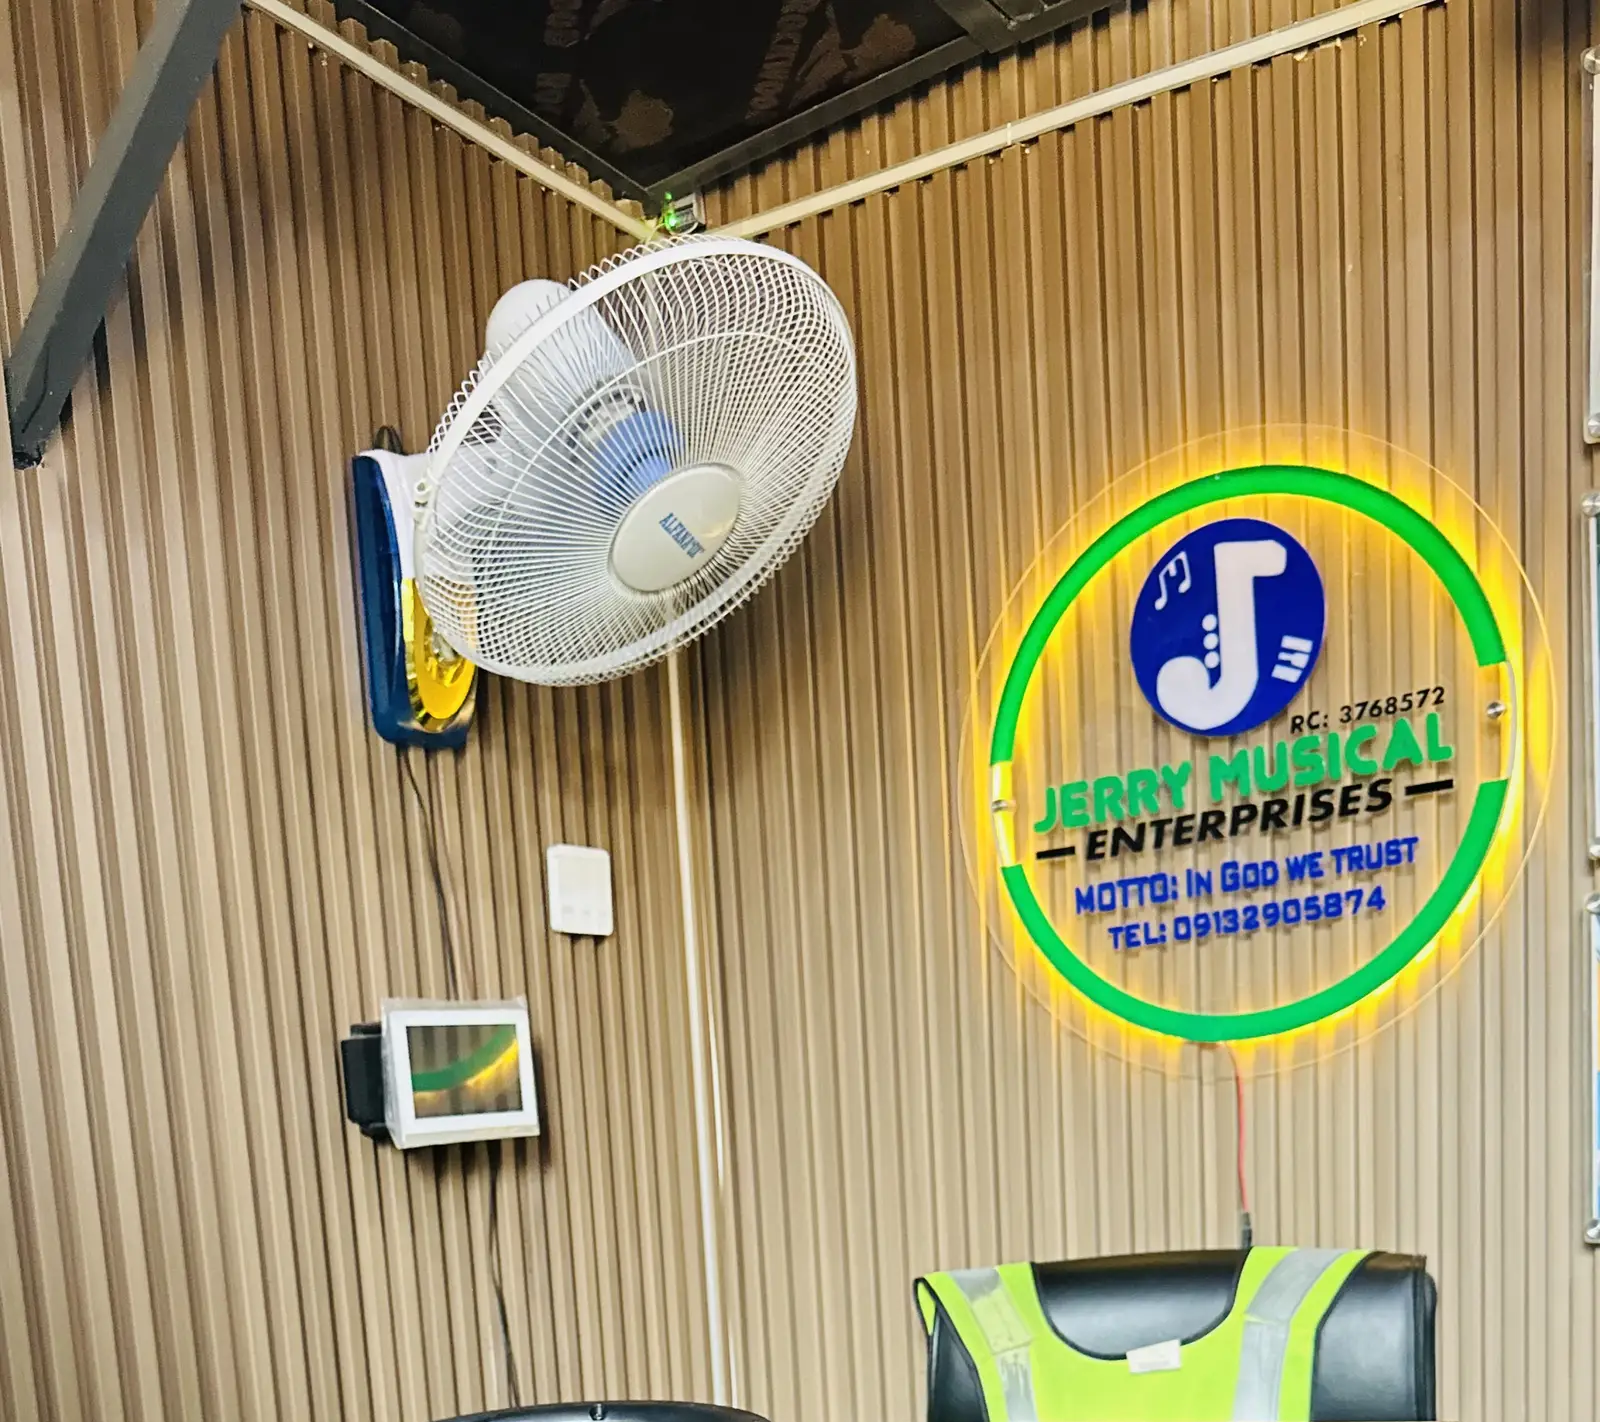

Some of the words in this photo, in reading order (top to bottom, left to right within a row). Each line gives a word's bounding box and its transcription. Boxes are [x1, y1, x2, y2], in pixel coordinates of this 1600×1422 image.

[1290, 712, 1328, 734] RC:
[1339, 685, 1446, 724] 3768572
[1033, 759, 1193, 834] JERRY
[1208, 711, 1454, 802] MUSICAL
[1085, 777, 1394, 861] ENTERPRISES
[1075, 872, 1178, 914] MOTTO:
[1286, 850, 1324, 881] WE
[1332, 836, 1419, 872] TRUST
[1108, 921, 1167, 950] TEL:
[1173, 884, 1387, 942] 09132905874
